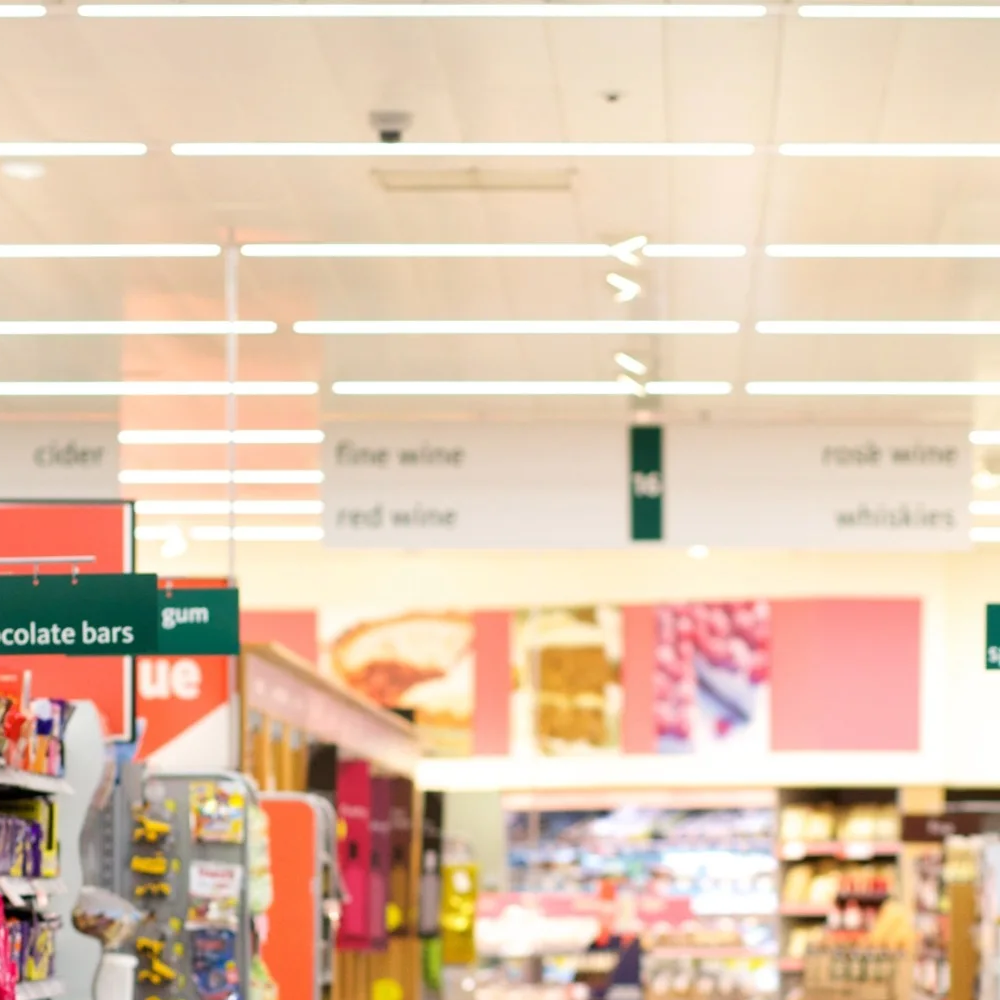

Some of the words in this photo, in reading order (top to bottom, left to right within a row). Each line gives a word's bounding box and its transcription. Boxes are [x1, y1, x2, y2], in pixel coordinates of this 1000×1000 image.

[33, 440, 104, 467] cider
[335, 440, 388, 467] fine
[397, 441, 465, 467] wine
[889, 441, 957, 467] wine
[337, 502, 384, 529] red
[390, 503, 457, 529] wine
[160, 606, 210, 631] gum
[82, 621, 134, 645] bars
[137, 658, 203, 700] ue
